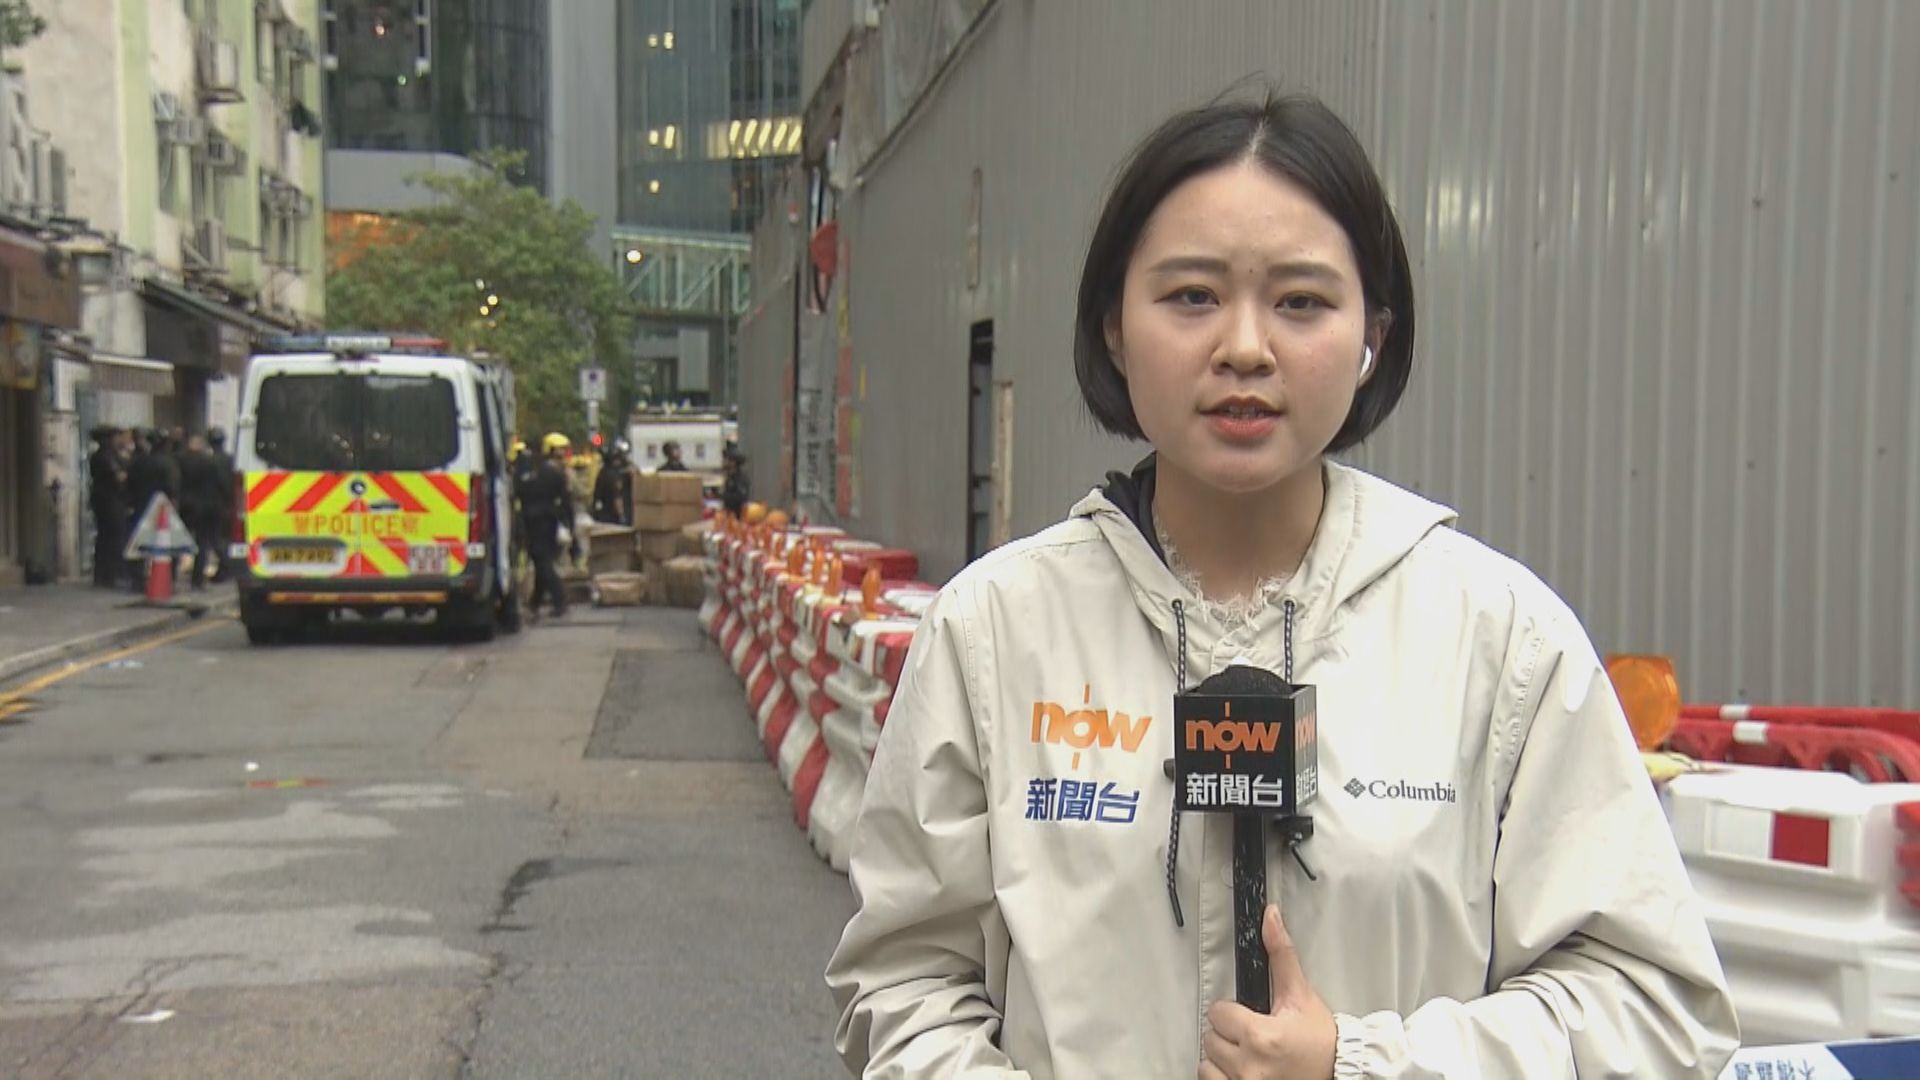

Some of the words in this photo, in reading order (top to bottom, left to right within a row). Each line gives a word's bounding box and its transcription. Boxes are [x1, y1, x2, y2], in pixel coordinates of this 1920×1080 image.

[314, 514, 399, 535] POLICE
[1031, 702, 1152, 753] now
[1185, 719, 1281, 752] now
[1025, 778, 1140, 823] 新聞台
[1186, 772, 1282, 806] 新聞台
